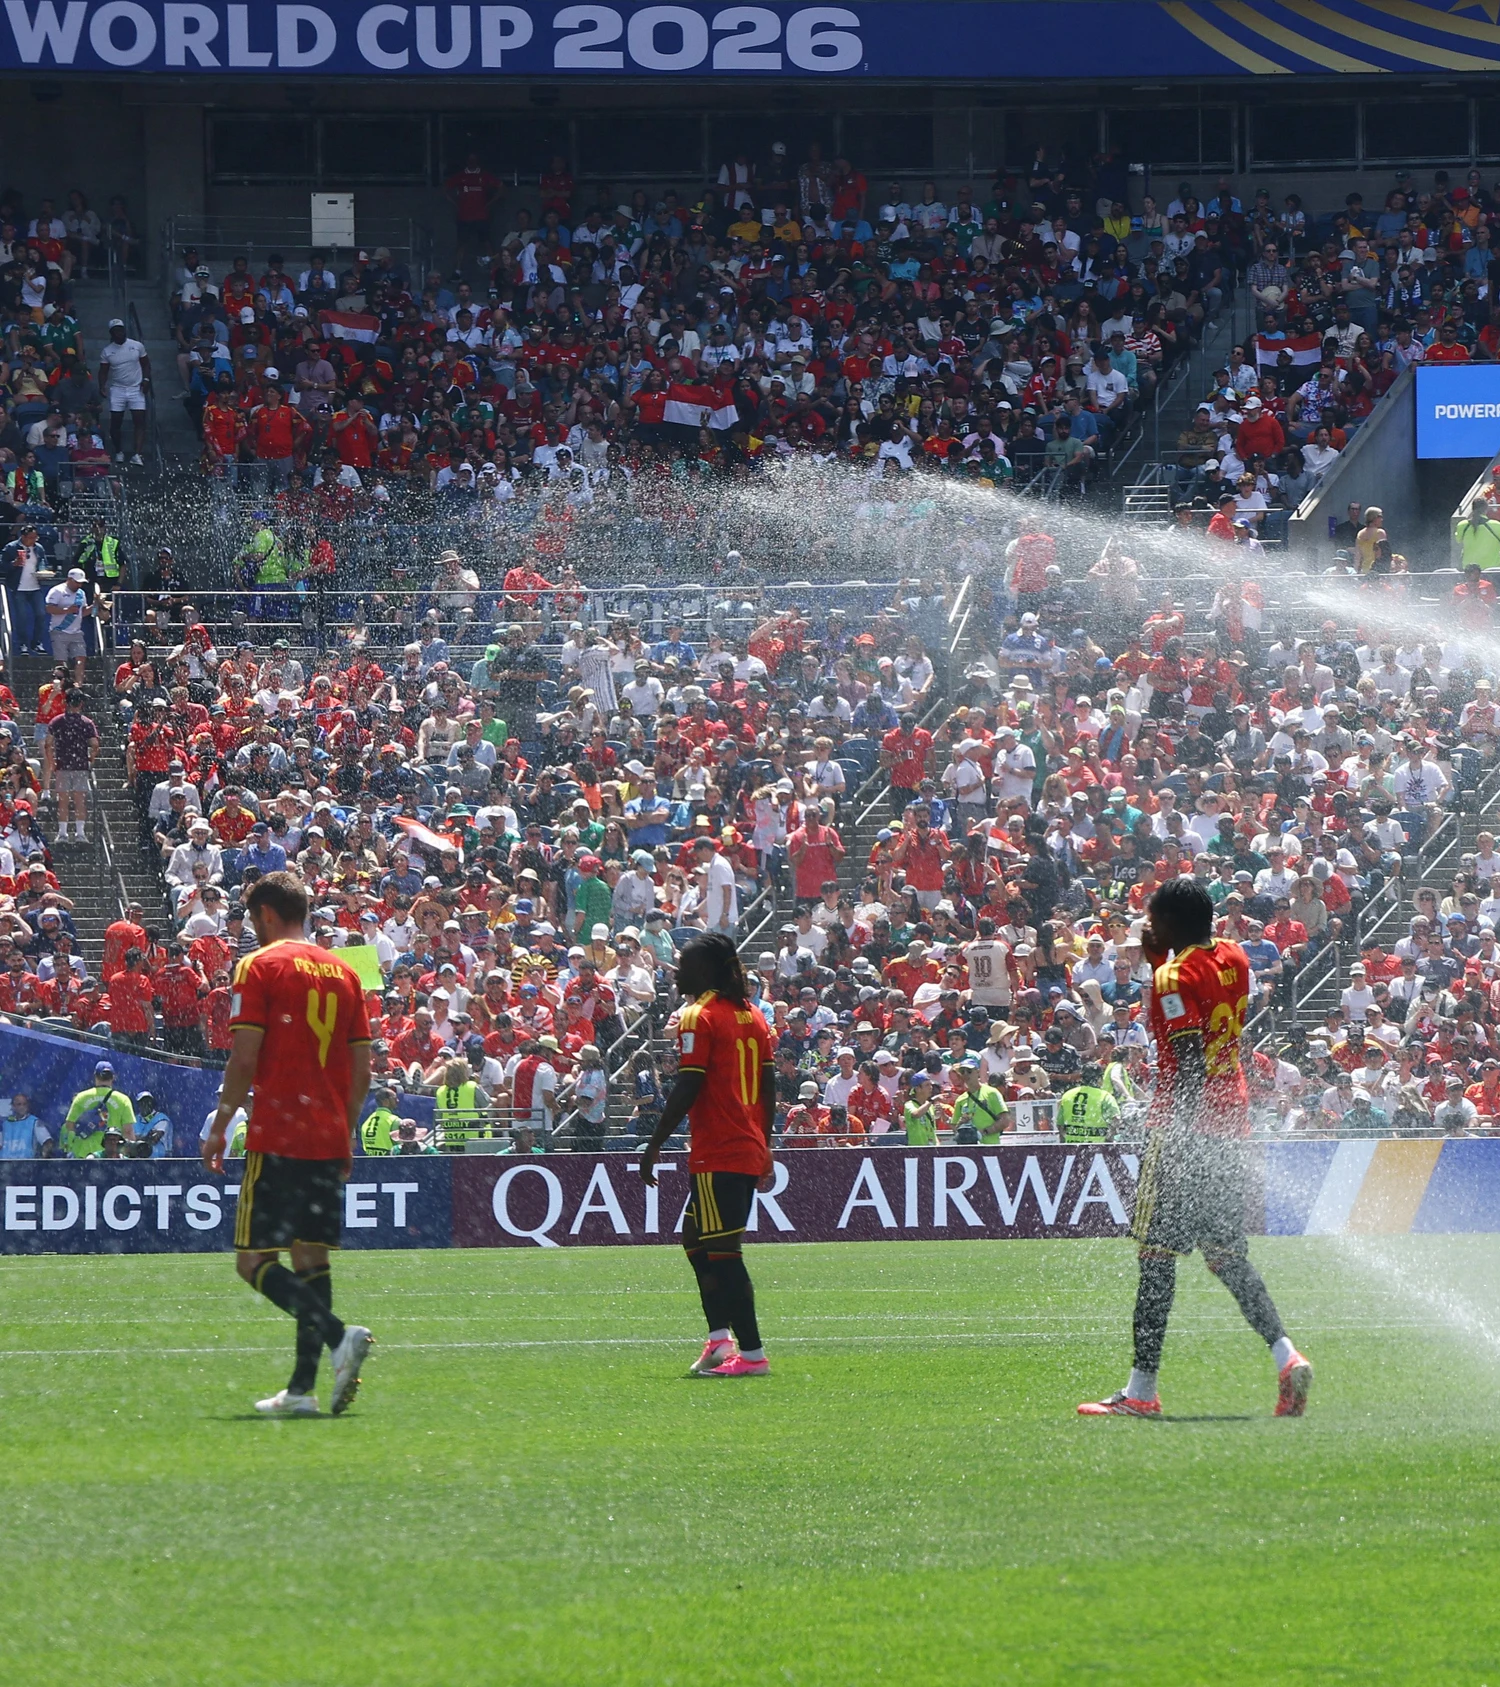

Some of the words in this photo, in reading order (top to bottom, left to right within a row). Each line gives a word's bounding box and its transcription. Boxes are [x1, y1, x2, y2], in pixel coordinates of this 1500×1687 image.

[4, 0, 337, 67] WORLD
[357, 4, 535, 69] CUP
[553, 4, 863, 72] 2026
[1114, 865, 1137, 879] Lee
[973, 955, 992, 978] 10
[306, 988, 338, 1069] 4
[736, 1037, 759, 1105] 11
[1017, 1114, 1031, 1127] VS
[5, 1182, 419, 1231] EDICTSET
[492, 1162, 797, 1247] QATR
[837, 1153, 1139, 1229] AIRWA
